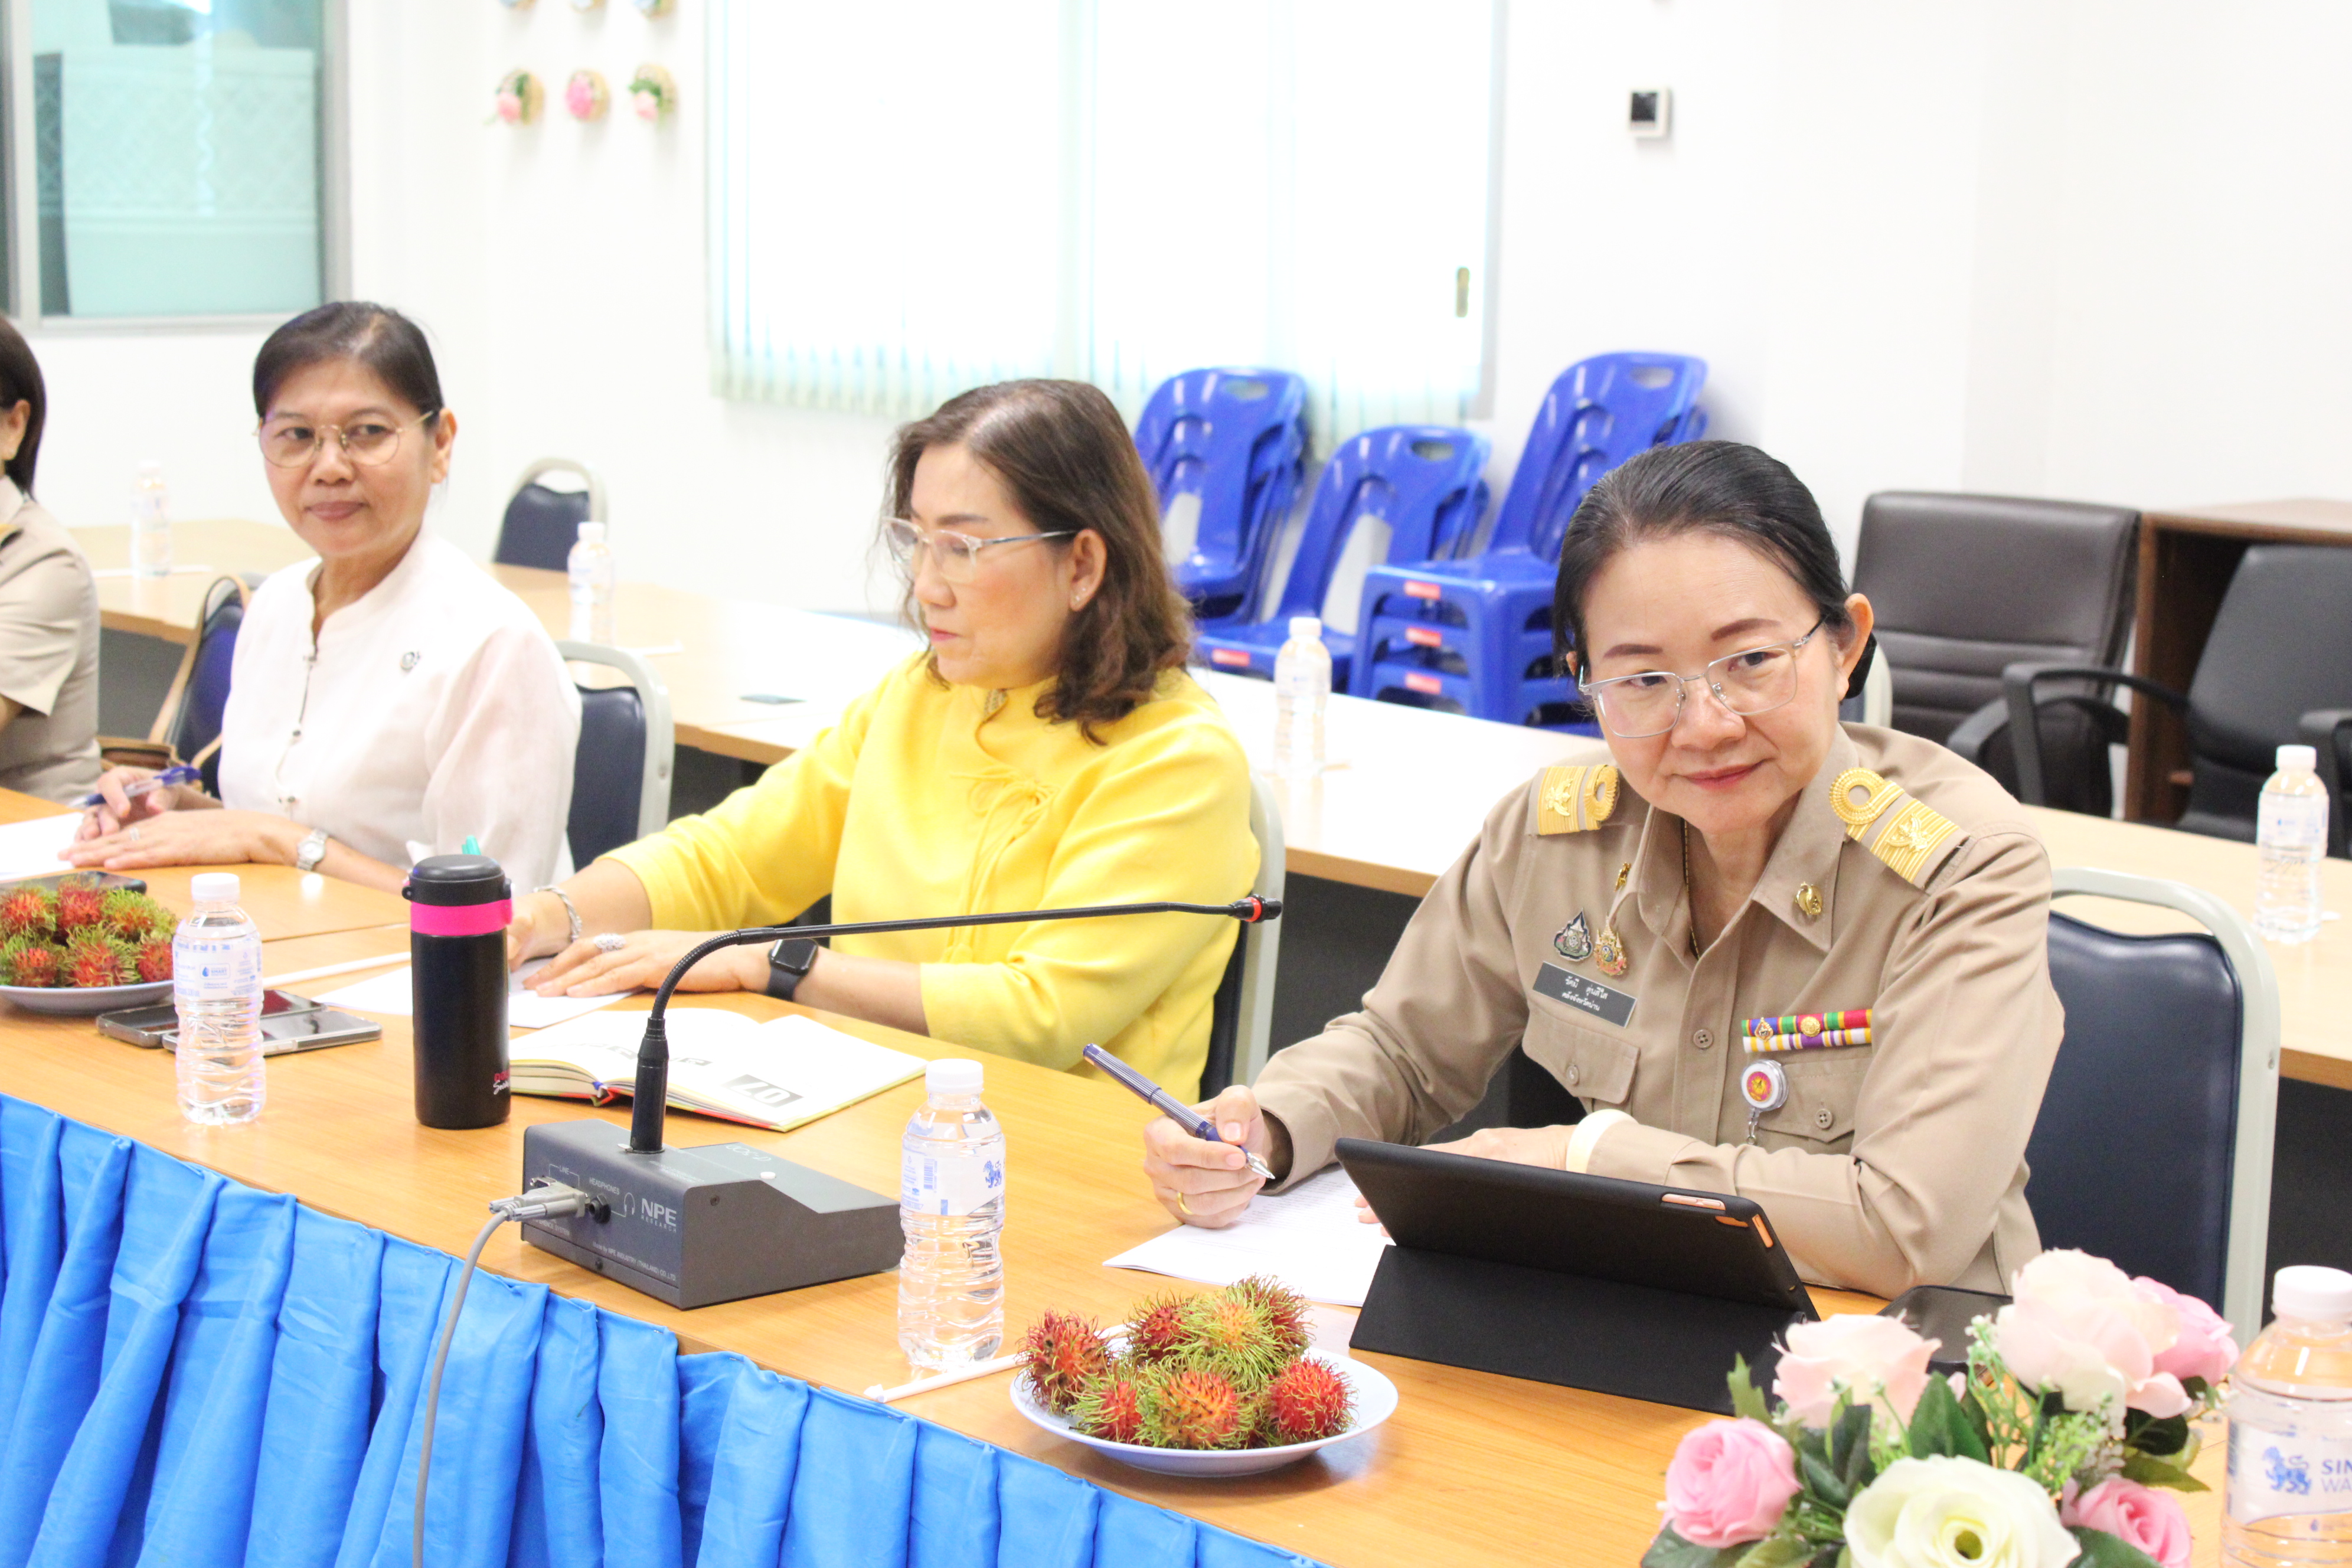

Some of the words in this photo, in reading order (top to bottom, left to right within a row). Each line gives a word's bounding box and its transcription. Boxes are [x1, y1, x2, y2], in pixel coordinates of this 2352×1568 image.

[559, 1165, 570, 1175] LINE
[589, 1177, 620, 1195] HEADPHONES
[641, 1197, 677, 1227] NPE
[641, 1214, 677, 1233] RESEARCH
[617, 1251, 636, 1264] INDUSTRY
[637, 1259, 660, 1276] (THAILAND)
